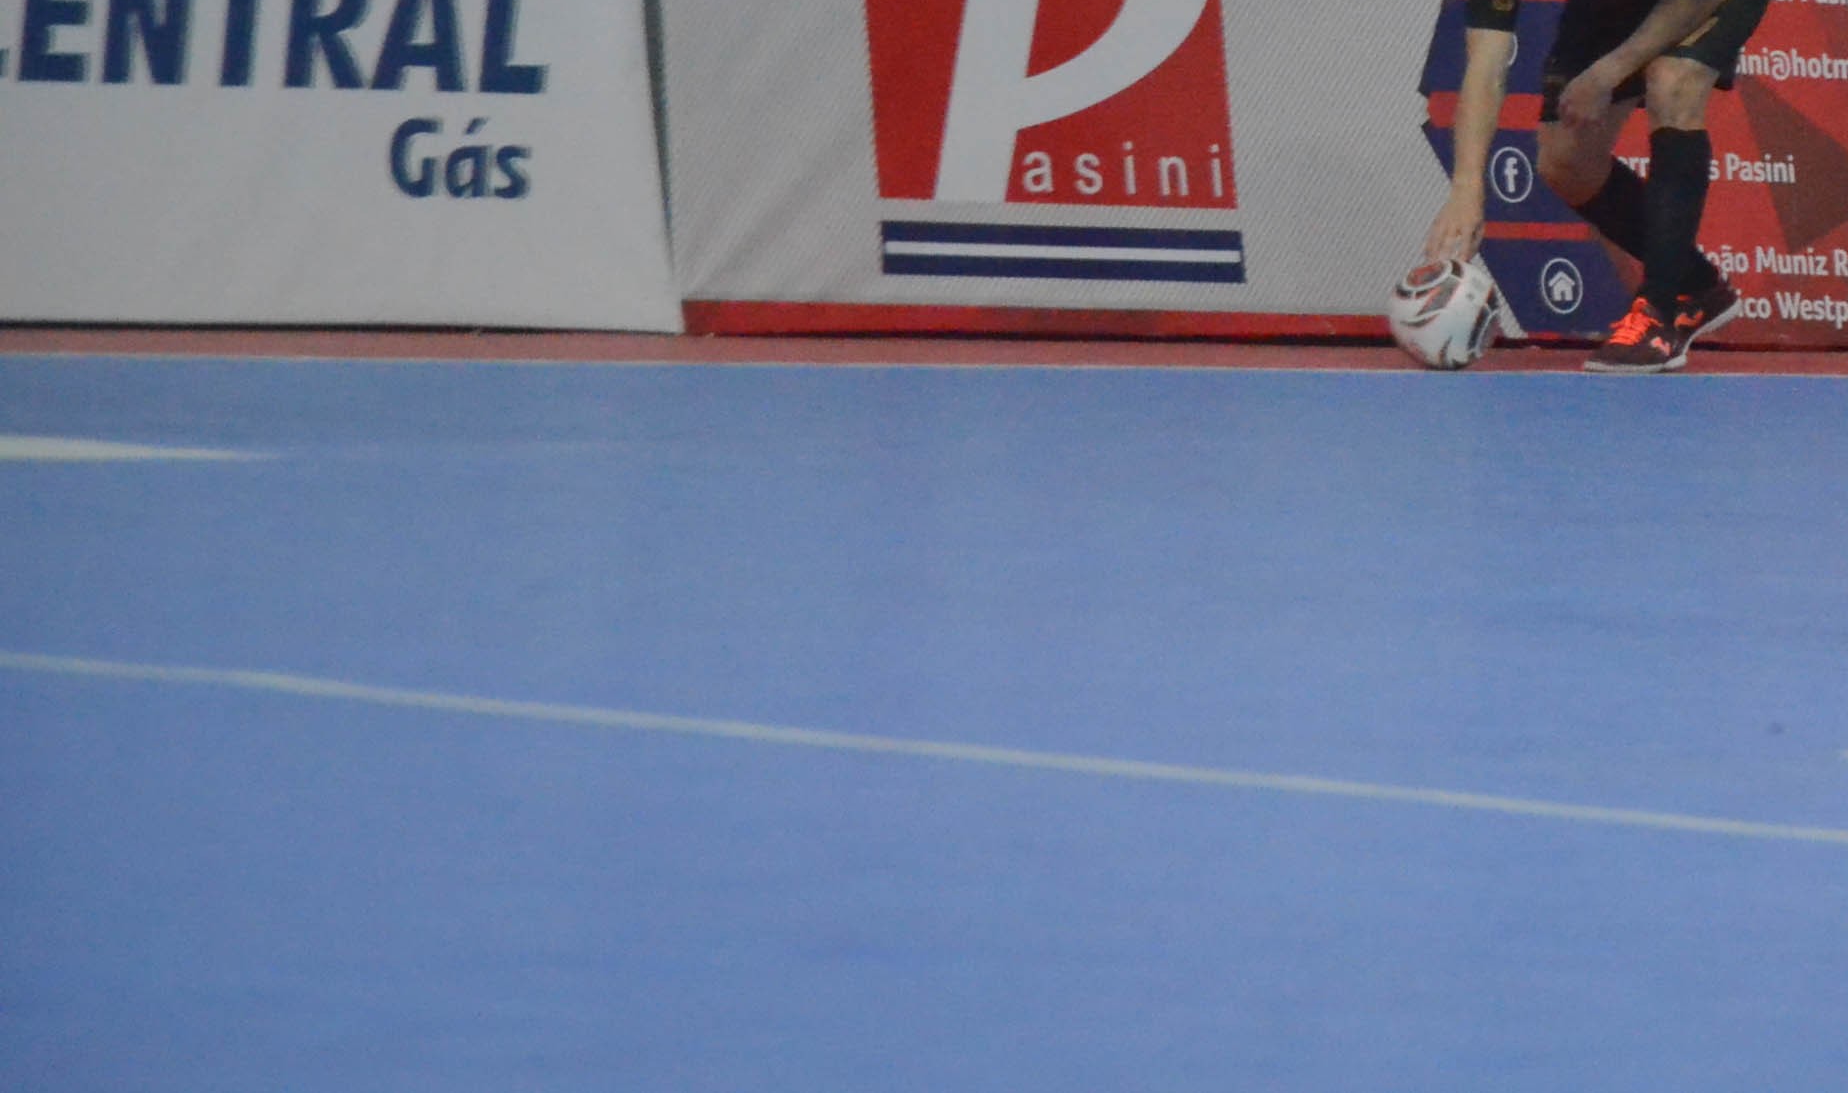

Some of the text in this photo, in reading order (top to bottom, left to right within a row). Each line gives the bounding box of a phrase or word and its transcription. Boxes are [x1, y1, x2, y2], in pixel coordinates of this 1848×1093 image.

[389, 117, 532, 200] Gás
[1724, 152, 1797, 184] Pasini
[1755, 245, 1829, 277] Muniz
